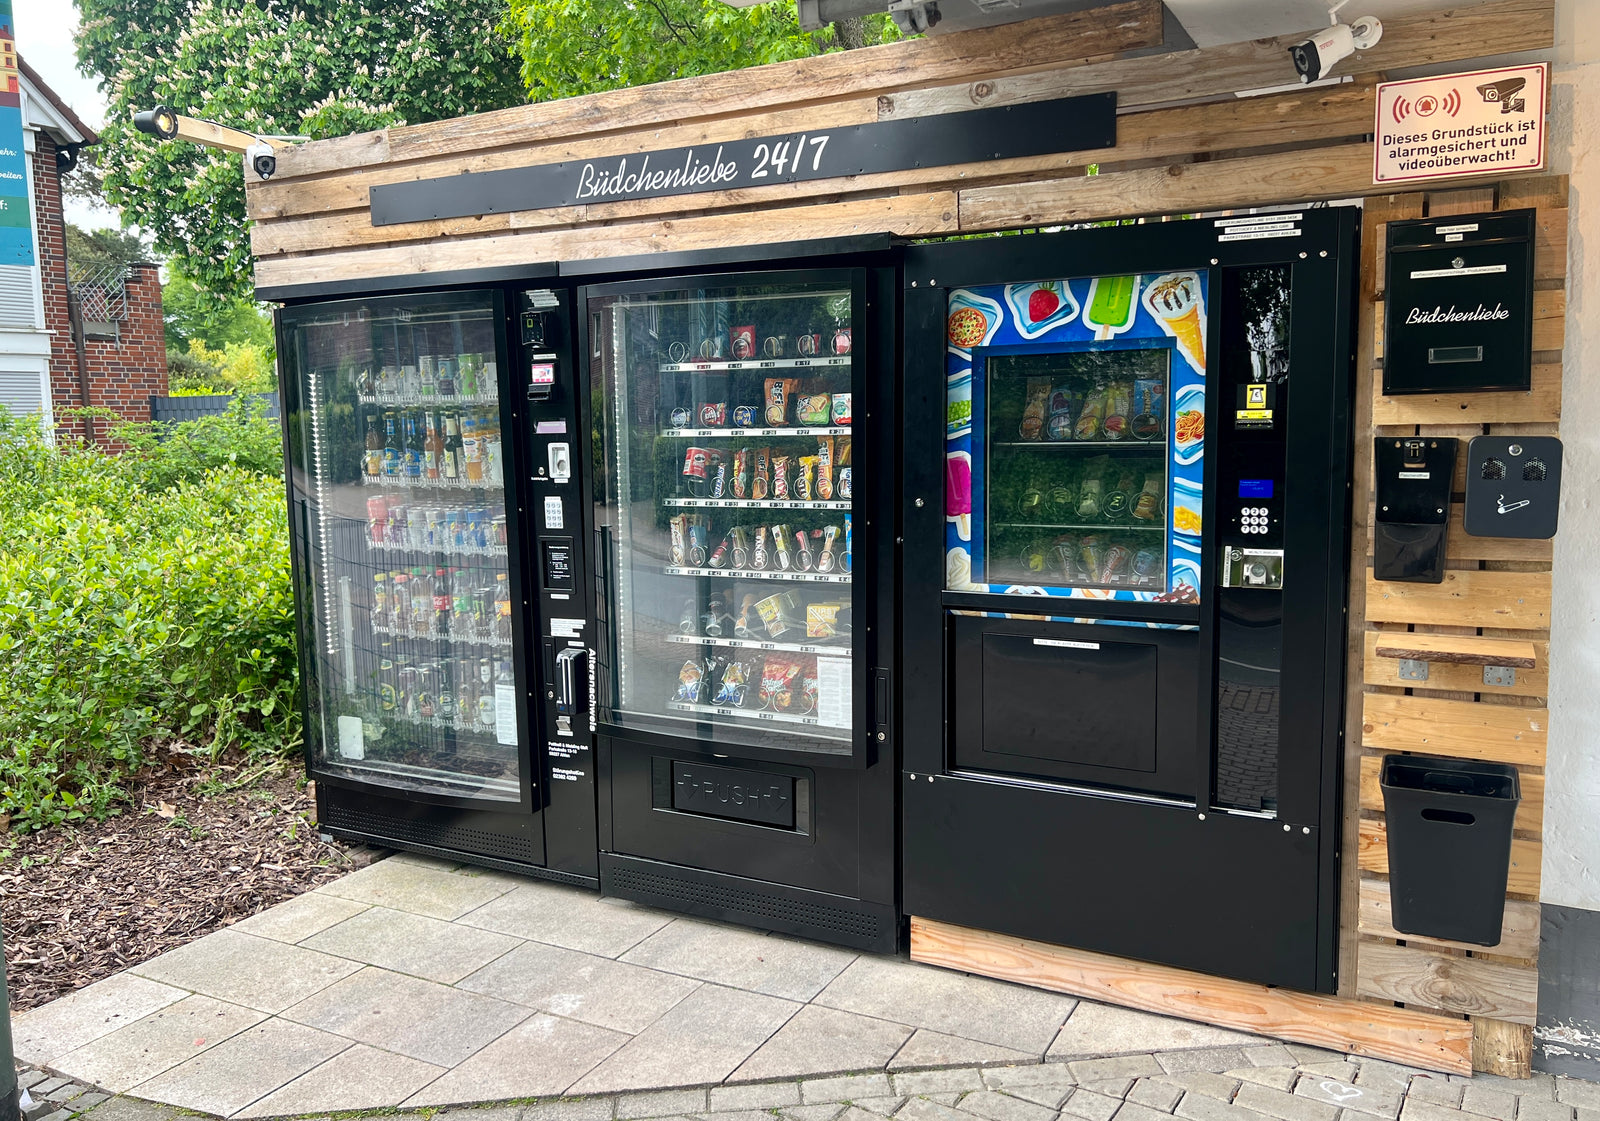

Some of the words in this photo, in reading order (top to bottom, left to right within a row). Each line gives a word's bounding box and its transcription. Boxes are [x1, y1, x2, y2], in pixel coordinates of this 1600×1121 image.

[1383, 132, 1428, 146] Dieses
[1432, 121, 1514, 141] Grundstück
[1517, 119, 1536, 131] ist
[1389, 136, 1496, 159] alarmgesichert
[1500, 134, 1527, 147] und
[1399, 149, 1516, 171] videoüberwacht!
[576, 145, 739, 199] Büdchenliebe
[751, 134, 830, 179] 24/7
[1405, 302, 1510, 325] Büdchenliebe
[588, 647, 597, 732] Altersnachweis
[703, 781, 760, 808] PUSH
